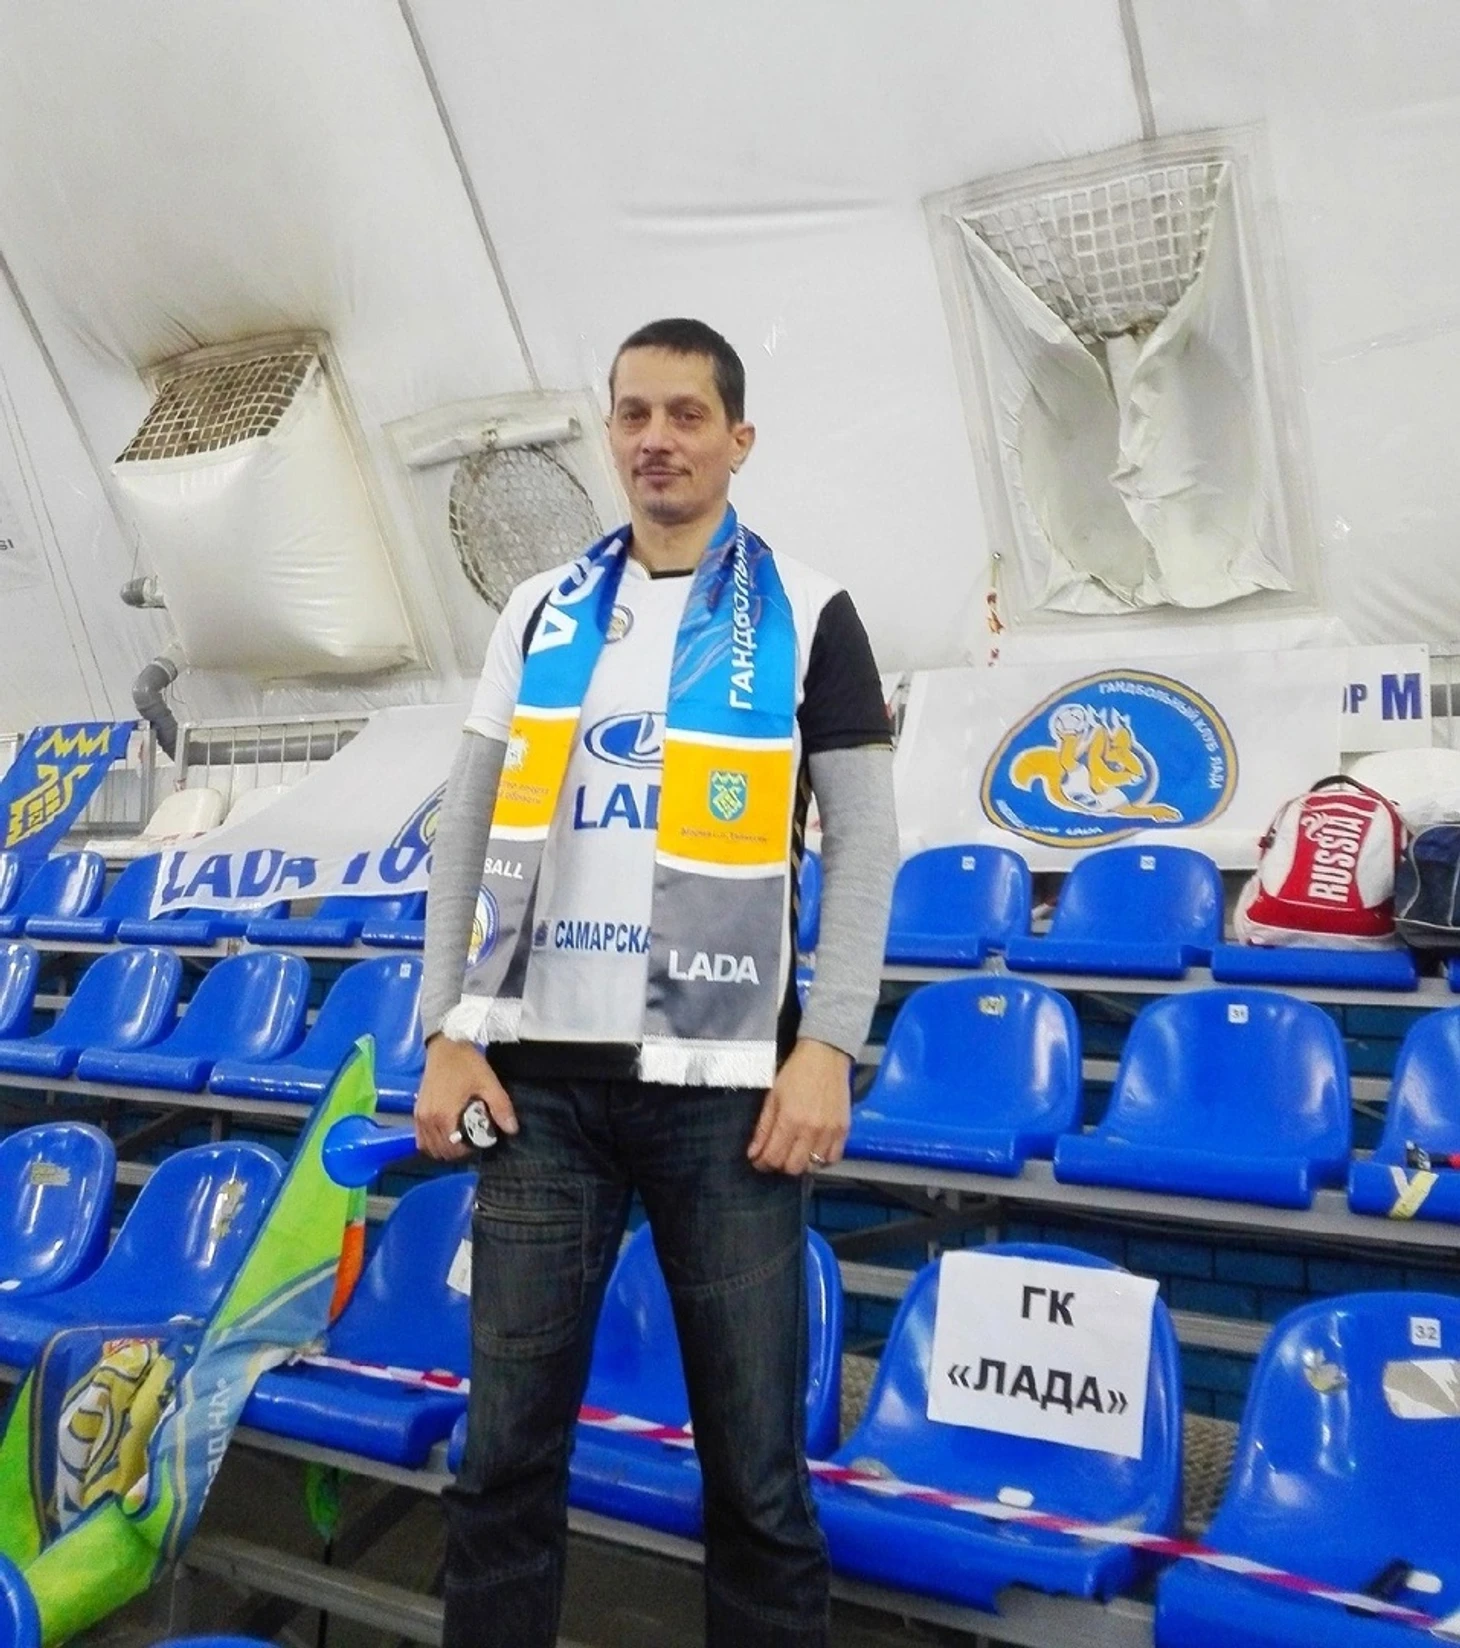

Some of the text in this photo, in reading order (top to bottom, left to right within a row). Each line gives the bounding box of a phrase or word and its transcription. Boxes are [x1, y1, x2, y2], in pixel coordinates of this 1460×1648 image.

[160, 848, 318, 906] LADA
[1308, 815, 1364, 903] RUSSIA
[668, 949, 760, 985] LADA
[1021, 1284, 1076, 1327] ГК
[1414, 1324, 1438, 1341] 32
[947, 1356, 1129, 1416] «ЛАДА»
